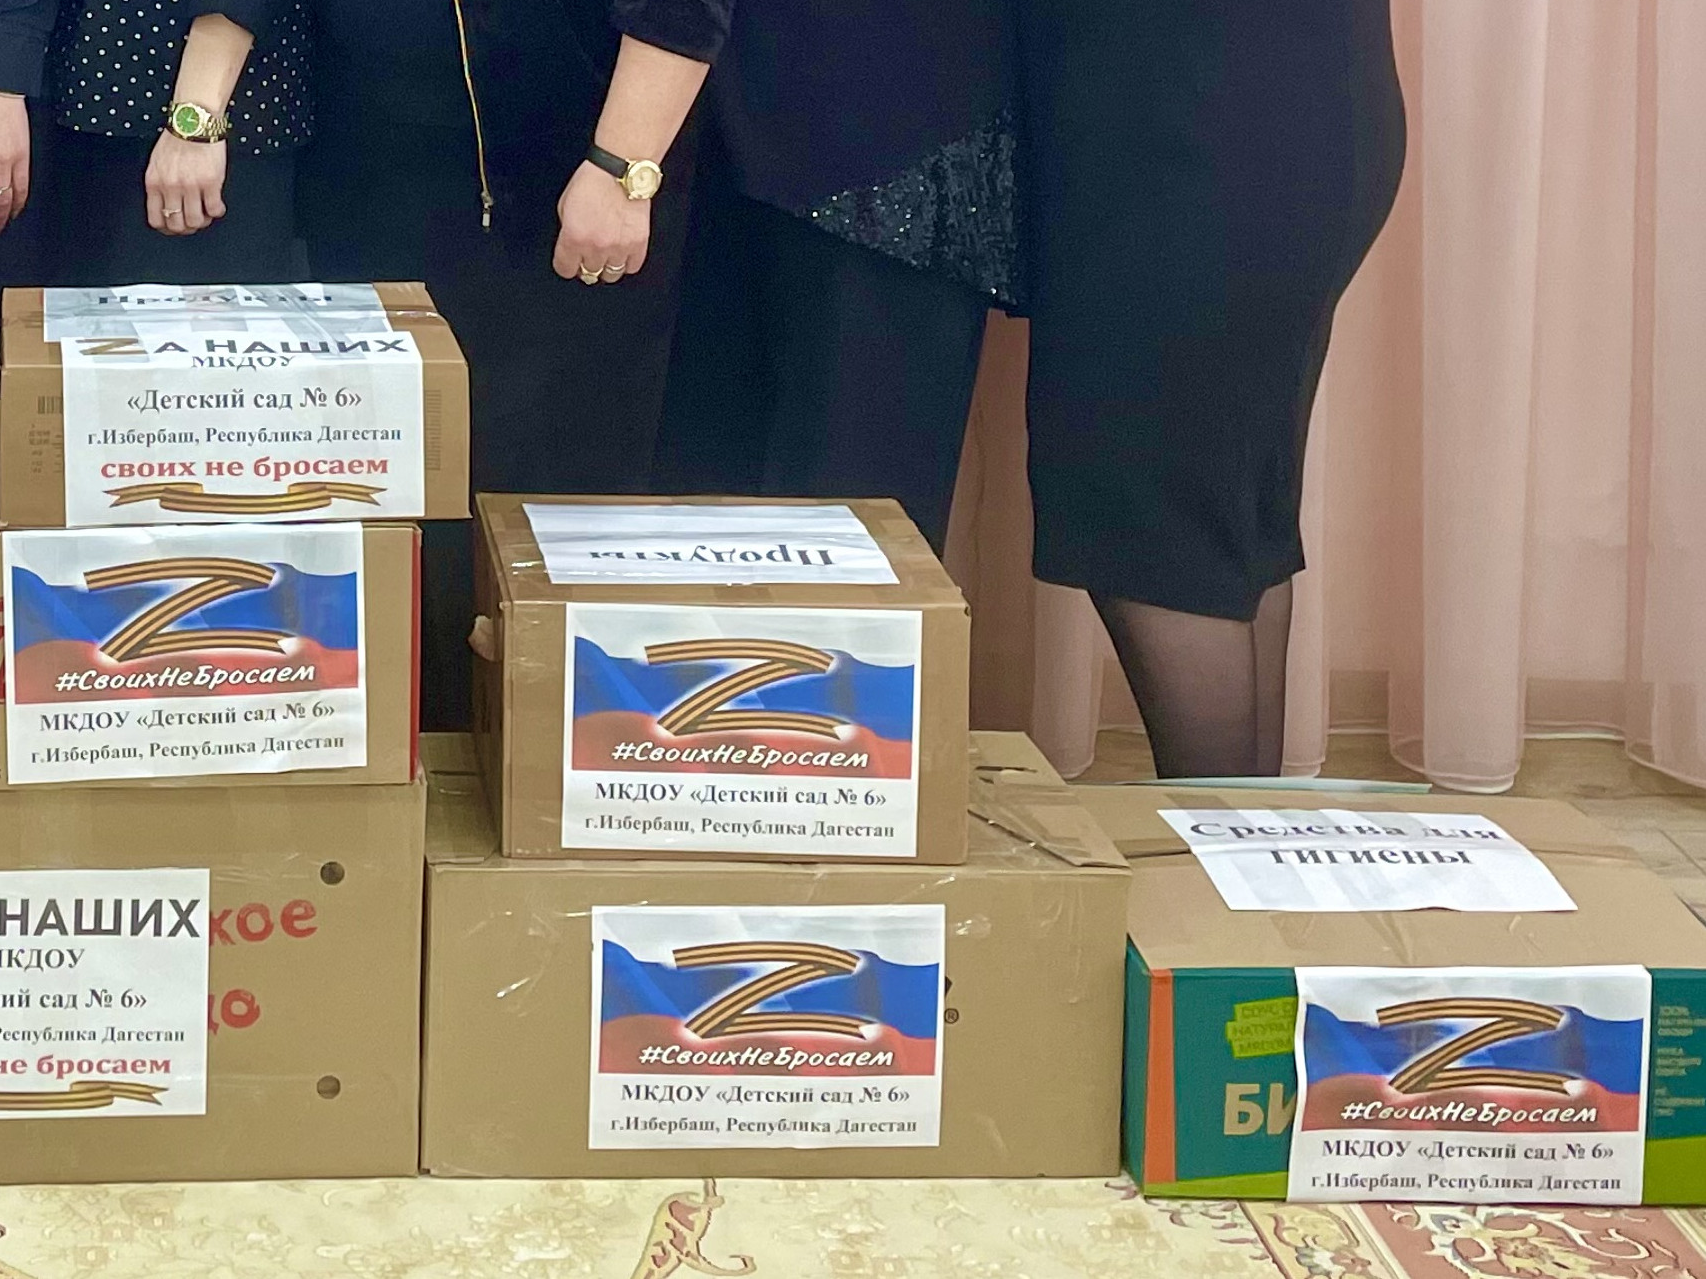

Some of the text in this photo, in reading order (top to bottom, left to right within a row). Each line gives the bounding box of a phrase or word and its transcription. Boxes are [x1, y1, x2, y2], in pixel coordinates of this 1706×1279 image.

[205, 338, 408, 357] НАШИХ
[192, 355, 298, 371] МКДОУ
[128, 387, 361, 413] «Детский сад № 6»
[206, 428, 312, 446] Республика
[317, 426, 400, 443] Дагестан
[100, 456, 389, 481] своих не бросаем
[590, 545, 834, 567] Продукты
[54, 662, 315, 693] #СвоихНеБросаем
[41, 701, 334, 732] МКДОУ «Детский сад № 6»
[150, 741, 255, 759] Республика
[262, 738, 344, 753] Дагестан
[611, 741, 870, 771] #СвоихНеБросаем
[596, 783, 886, 805] МКДОУ «Детский сад № 6»
[702, 818, 806, 837] Республика
[811, 821, 894, 837] Дагестан
[1190, 822, 1506, 839] Средства для
[1268, 849, 1471, 864] гигиены
[40, 995, 77, 1009] сад
[85, 989, 112, 1008] №
[121, 989, 146, 1007] 6»
[102, 1027, 184, 1043] Дагестан
[36, 1054, 171, 1079] бросаем
[638, 1046, 894, 1071] #СвоихНеБросаем
[623, 1085, 909, 1104] МКДОУ «Детский сад № 6»
[1341, 1102, 1597, 1126] #СвоихНеБросаем
[727, 1118, 830, 1135] Республика
[835, 1119, 916, 1134] Дагестан
[1324, 1140, 1613, 1160] МКДОУ «Детский сад № 6»
[1428, 1174, 1532, 1192] Республика
[1538, 1176, 1620, 1191] Дагестан
